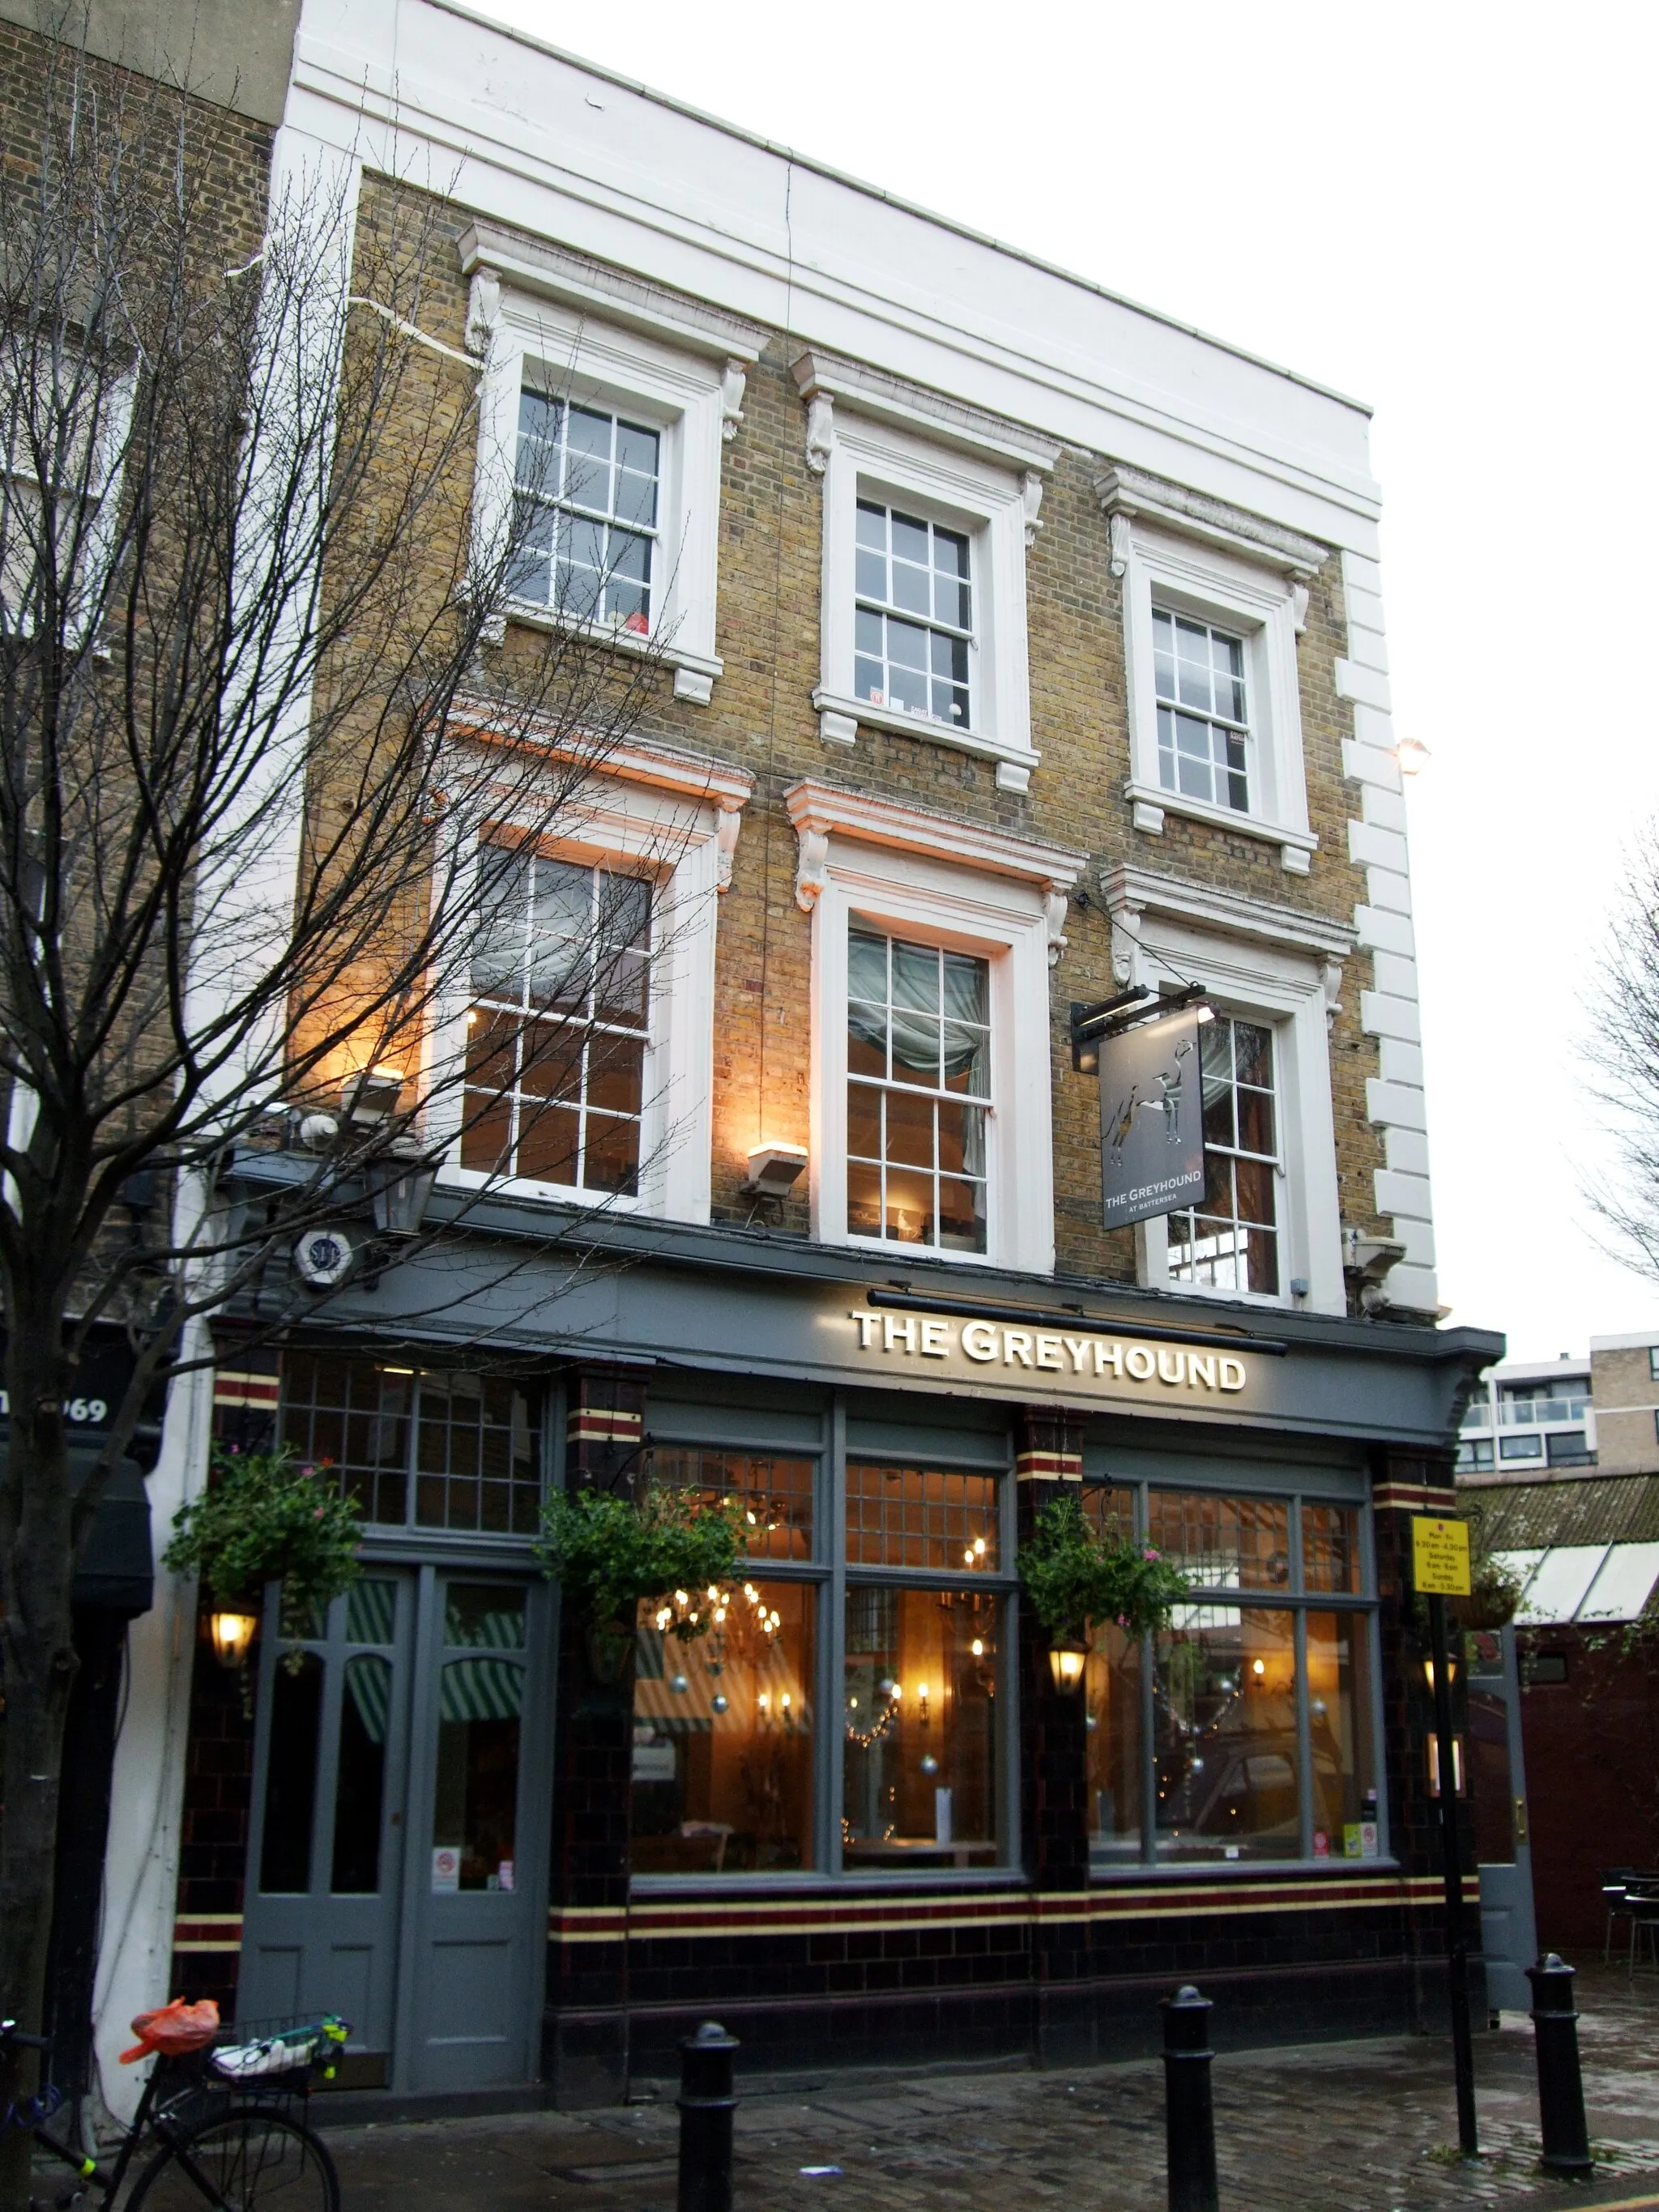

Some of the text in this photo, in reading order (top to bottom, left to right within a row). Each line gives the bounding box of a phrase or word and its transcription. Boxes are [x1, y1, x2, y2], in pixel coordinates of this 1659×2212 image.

[1105, 1170, 1201, 1208] THE GREYHOUND
[1128, 1193, 1178, 1213] AT BATTERSEA
[851, 1311, 1247, 1392] THE GREYHOUND
[1429, 1553, 1455, 1562] Saturday
[1432, 1573, 1454, 1583] Sunday
